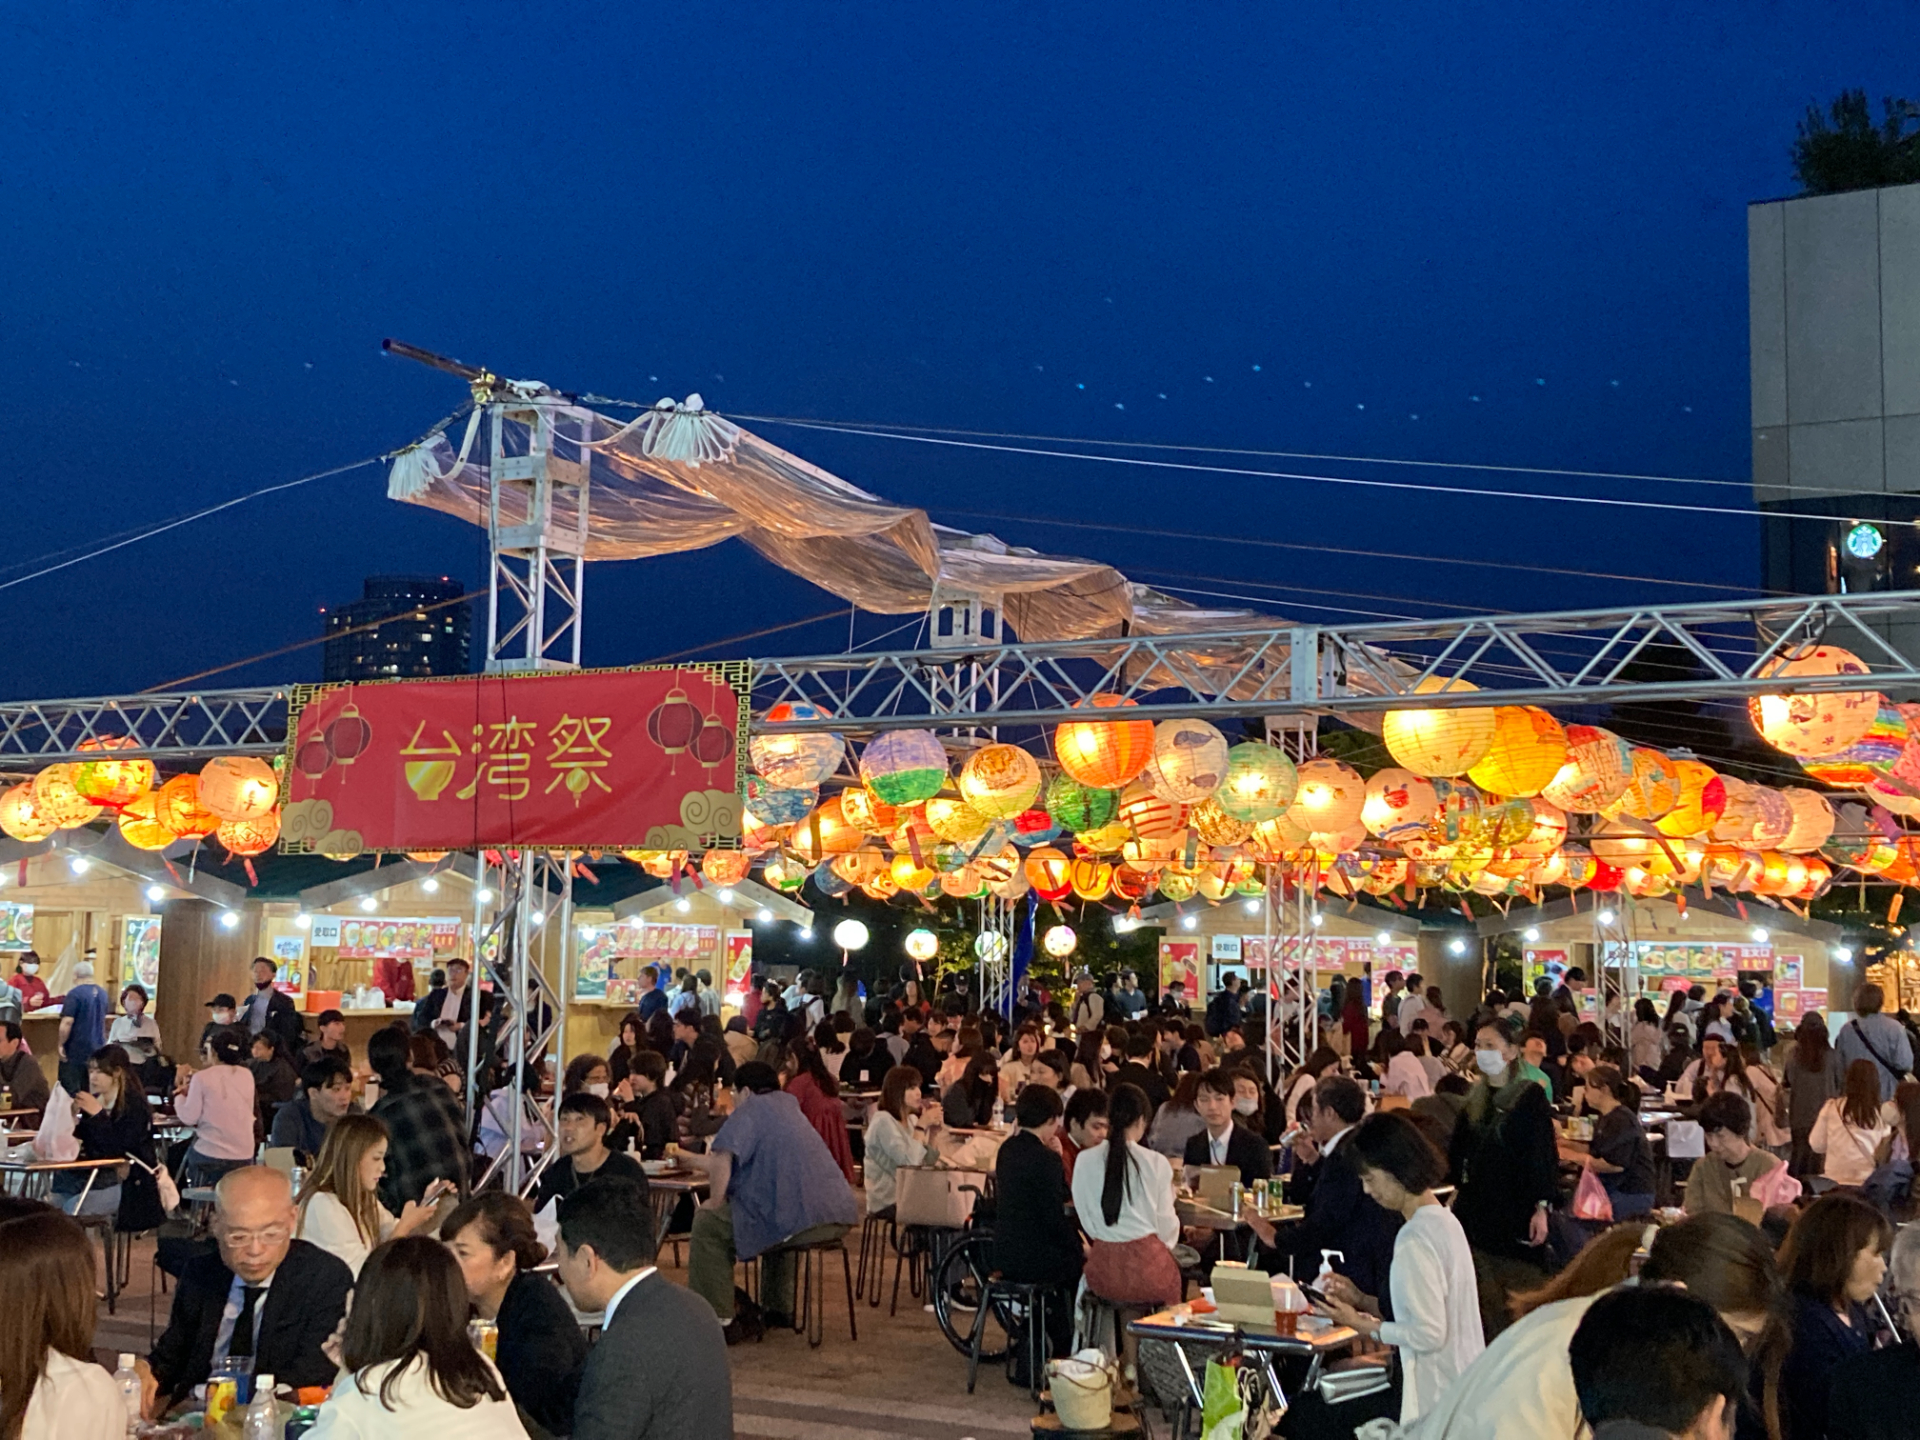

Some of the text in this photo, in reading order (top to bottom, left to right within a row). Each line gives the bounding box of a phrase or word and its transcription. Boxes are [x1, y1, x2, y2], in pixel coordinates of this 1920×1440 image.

[400, 713, 612, 808] 台湾祭
[314, 927, 338, 937] 受取口
[1215, 943, 1238, 952] 受取口
[1741, 948, 1770, 957] 注文口
